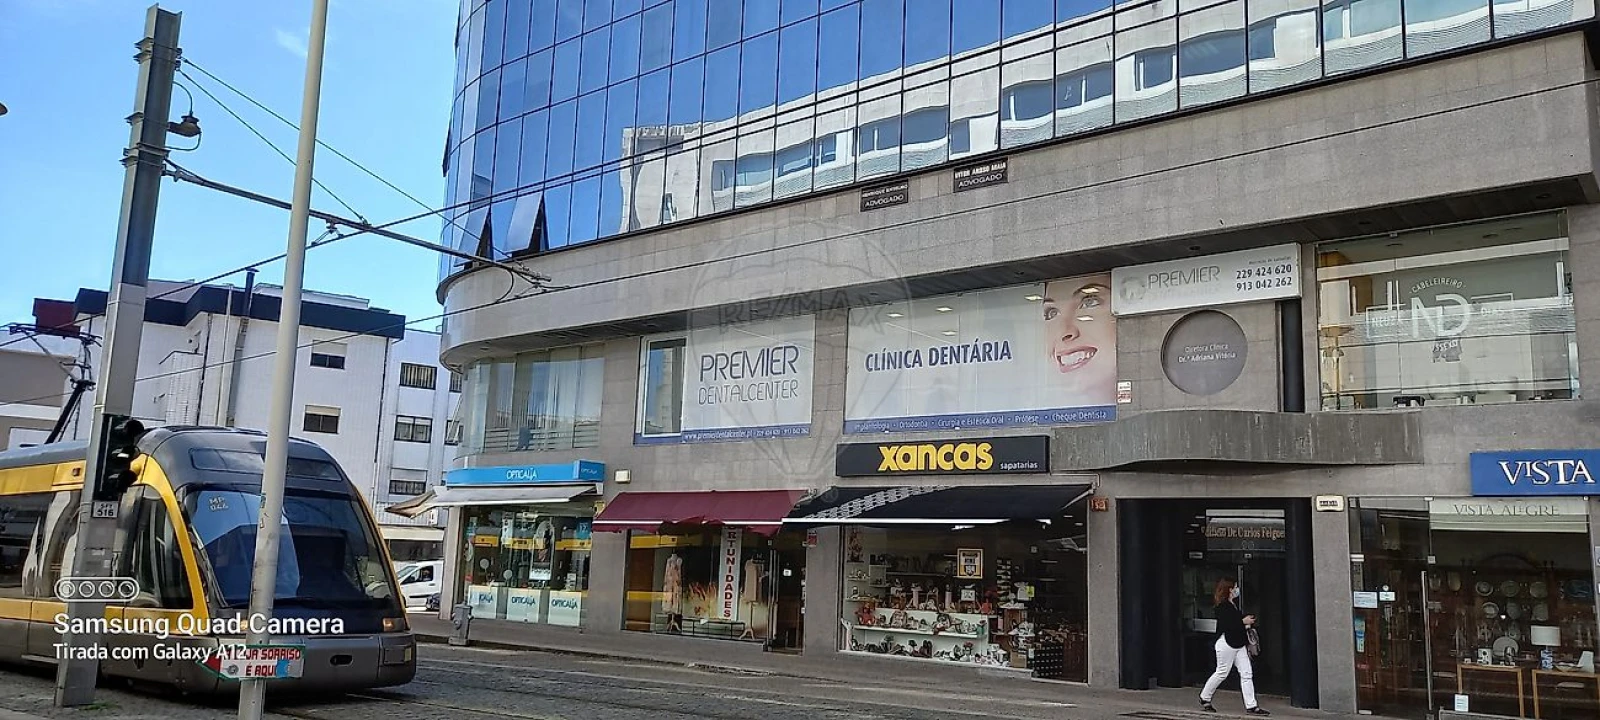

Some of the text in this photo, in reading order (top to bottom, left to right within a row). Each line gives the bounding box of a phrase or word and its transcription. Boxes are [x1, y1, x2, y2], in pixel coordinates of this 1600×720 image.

[958, 173, 1003, 187] ADVOGADO
[864, 194, 904, 208] ADVOGADO
[1147, 265, 1221, 290] PREMIER
[1236, 263, 1292, 280] 229 424 620
[1236, 276, 1292, 291] 913 042 262
[1411, 277, 1463, 293] CABELEIREIRO
[865, 338, 1013, 372] CLÍNICA DENTÁRIA
[699, 345, 800, 383] PREMIER
[698, 379, 799, 405] DENTALCENTER
[990, 413, 1004, 425] Oral
[1051, 411, 1077, 424] Cheque
[1078, 409, 1108, 421] Dentista
[877, 441, 1039, 472] xancas sapatarias
[1498, 458, 1596, 485] VISTA
[1453, 504, 1561, 517] VISTA ALEGRE
[261, 648, 301, 660] SORRISO
